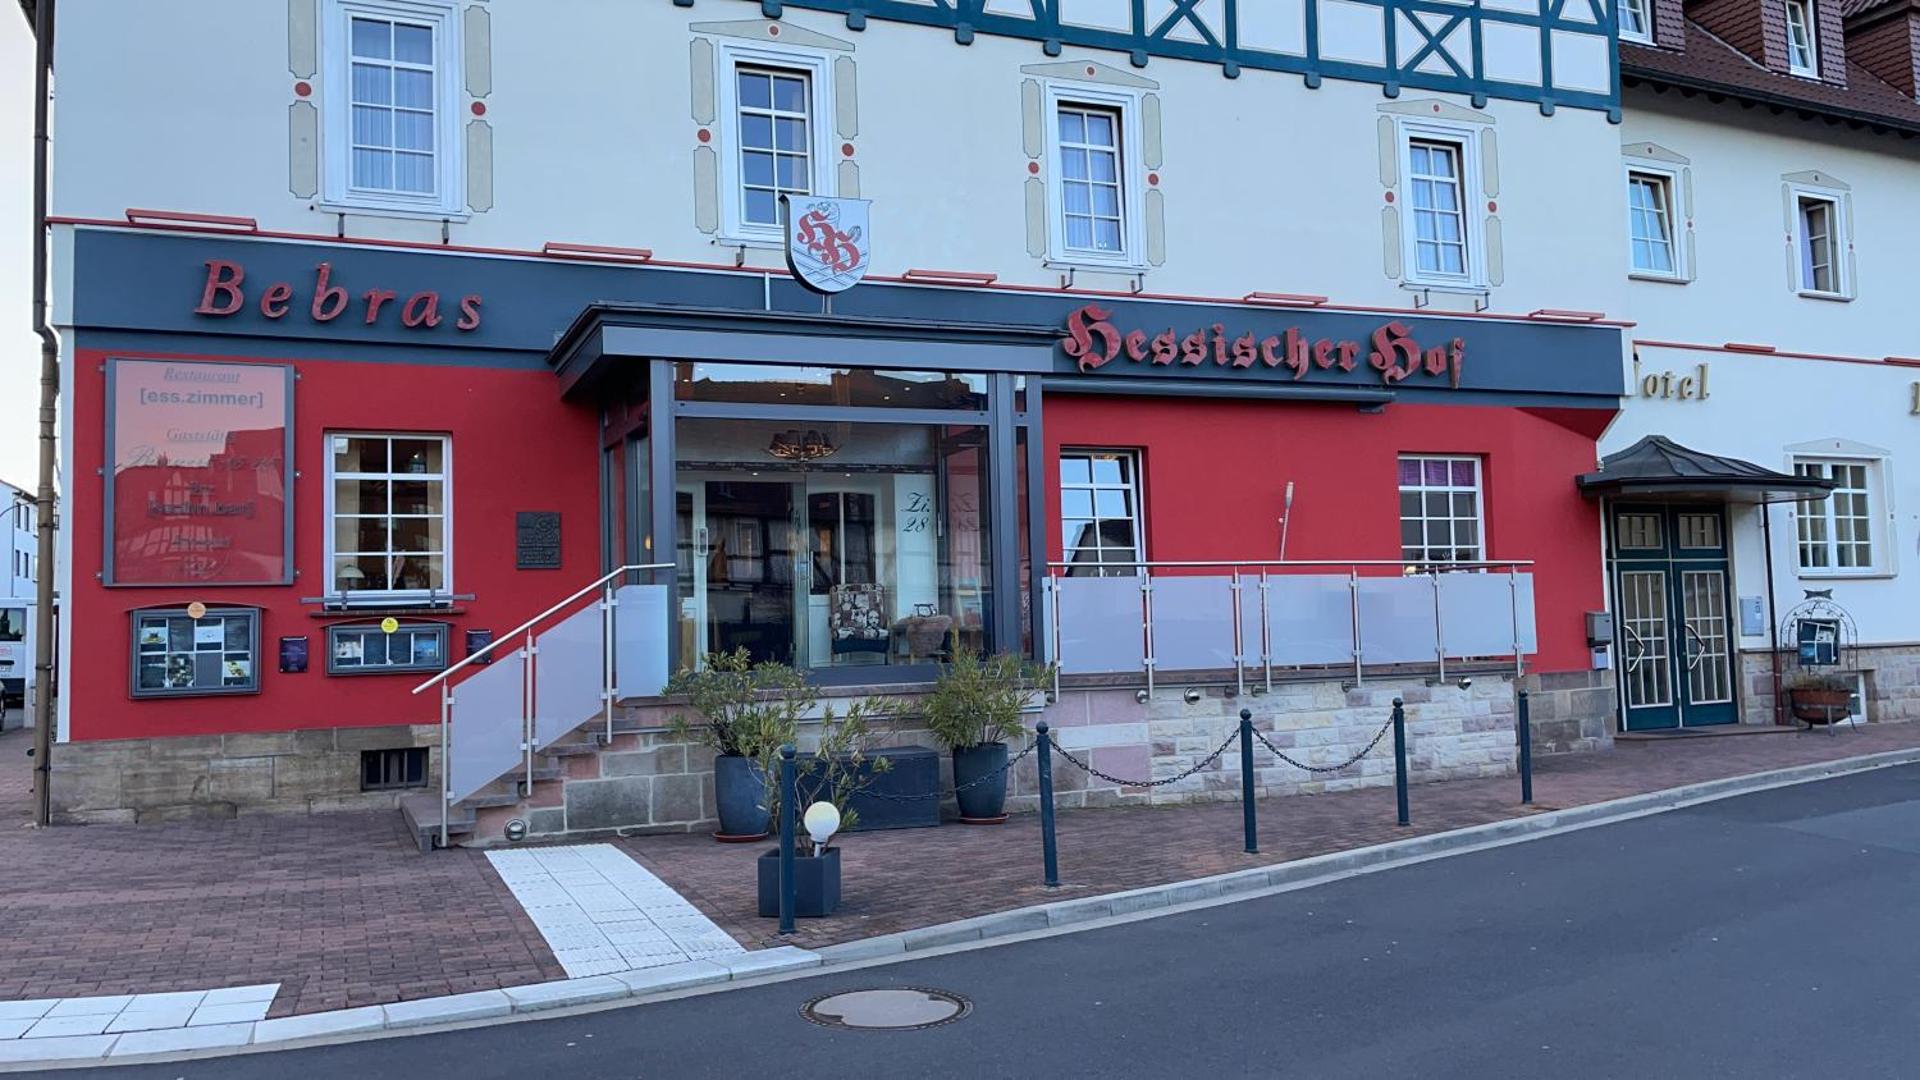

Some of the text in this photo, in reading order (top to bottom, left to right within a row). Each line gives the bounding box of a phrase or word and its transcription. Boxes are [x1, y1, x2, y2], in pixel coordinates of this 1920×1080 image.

[194, 259, 483, 331] Bebras
[1062, 303, 1466, 390] Hessischer Hof
[163, 367, 241, 384] Restaurant
[1633, 361, 1710, 400] otel
[140, 387, 264, 409] [ess.zimmer]
[903, 516, 929, 533] 28
